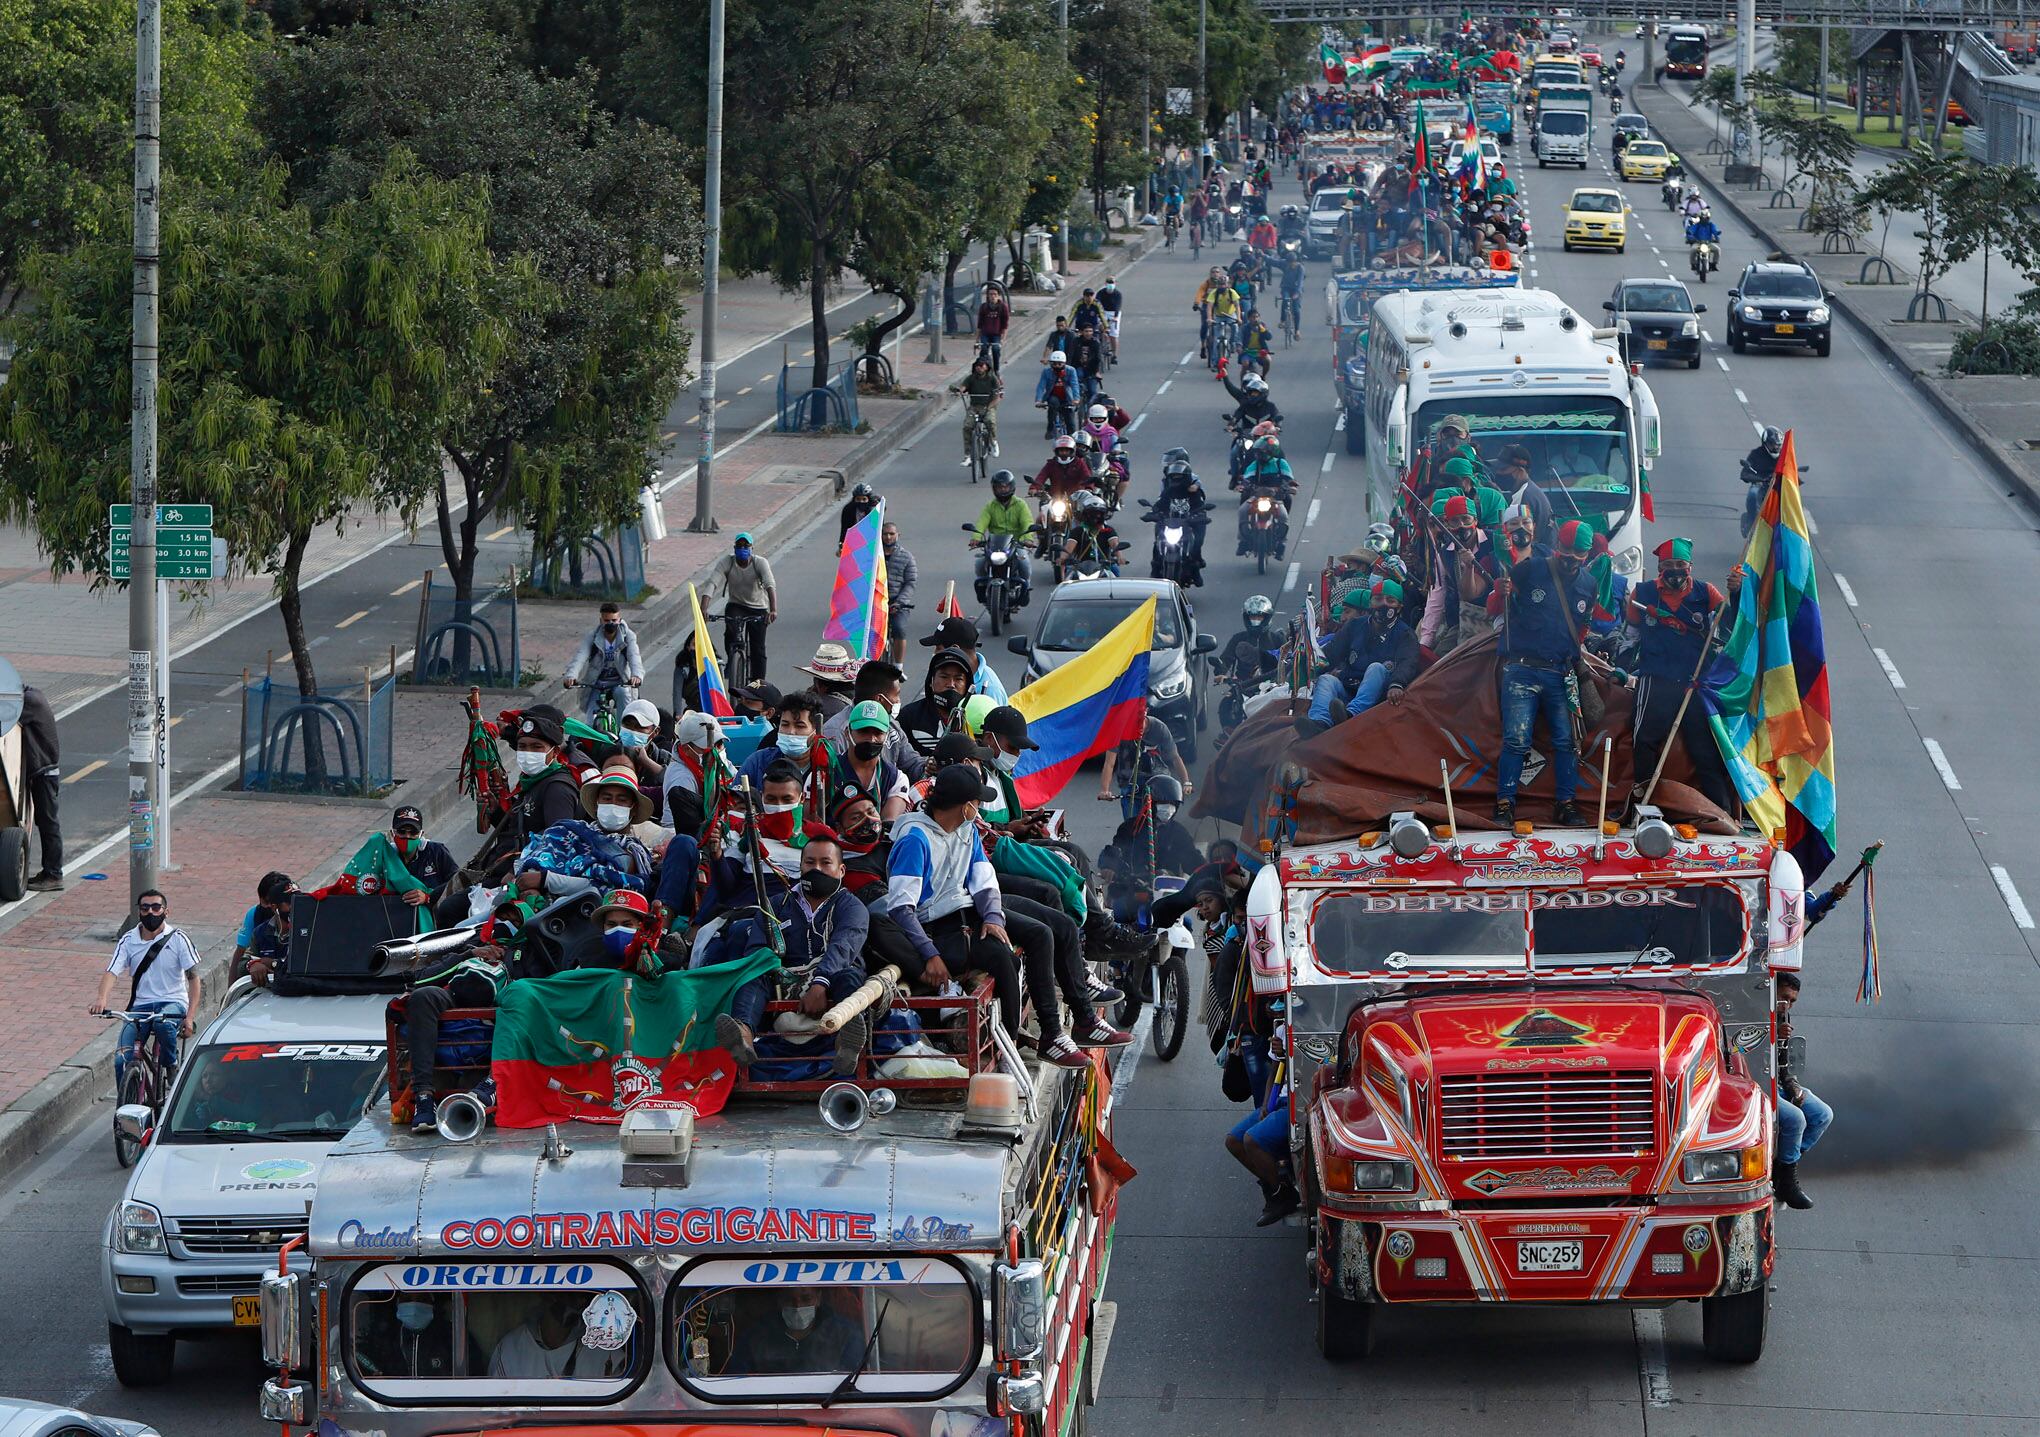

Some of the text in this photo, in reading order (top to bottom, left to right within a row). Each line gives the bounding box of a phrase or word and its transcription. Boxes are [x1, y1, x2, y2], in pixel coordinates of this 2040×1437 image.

[180, 534, 191, 542] 1.5
[194, 534, 207, 542] km
[179, 566, 191, 574] 3.5
[194, 566, 207, 574] km
[1362, 889, 1696, 913] DEPREDADOR
[262, 1045, 387, 1057] SPORT
[220, 1183, 317, 1192] PRENSA
[338, 1219, 416, 1249] Ciudad
[441, 1207, 876, 1250] COOTRANSGIGANTE
[893, 1215, 921, 1242] La
[402, 1265, 594, 1286] ORGULLO
[743, 1261, 906, 1283] OPITA
